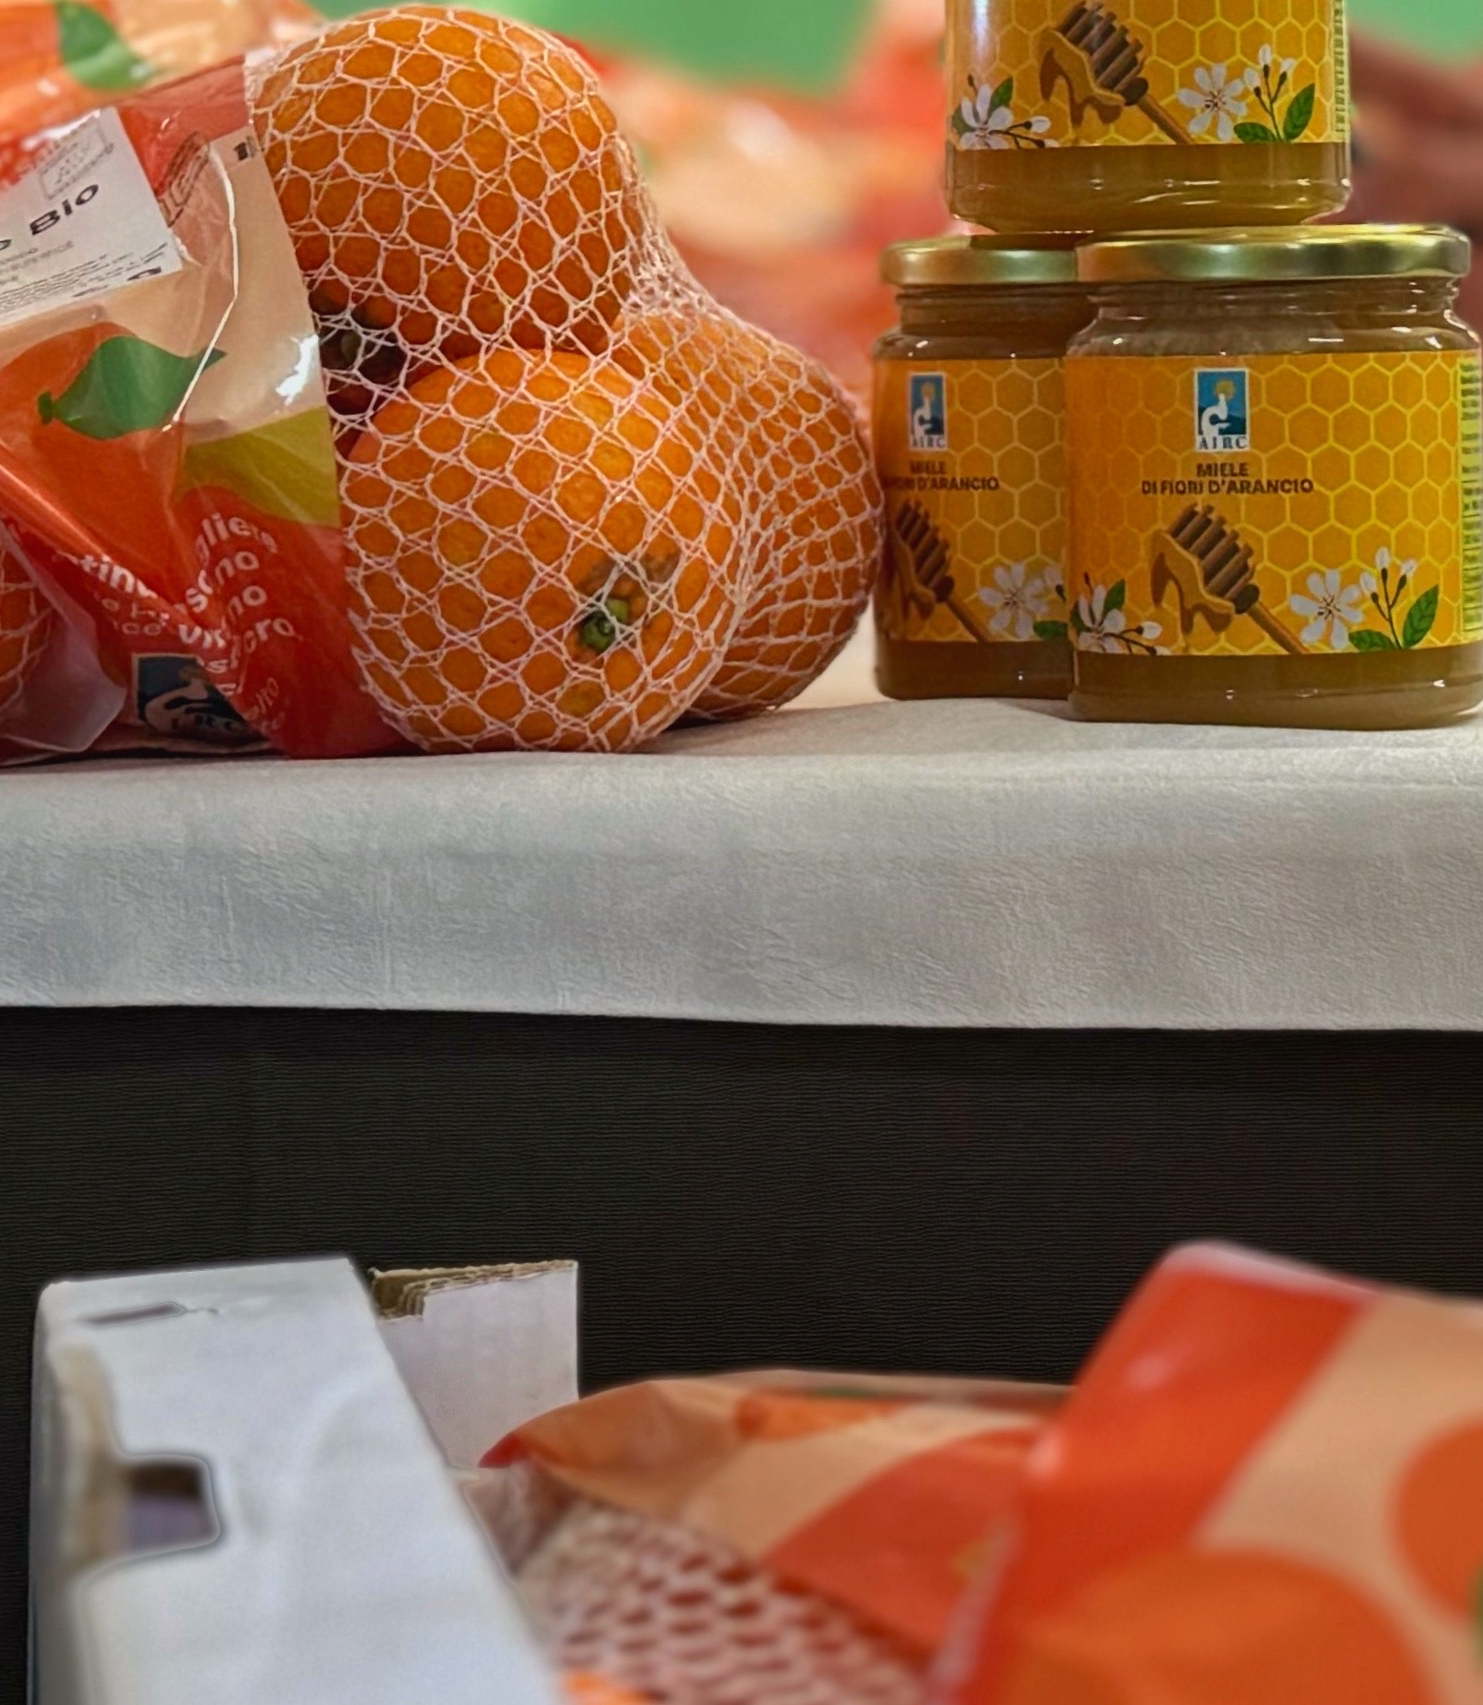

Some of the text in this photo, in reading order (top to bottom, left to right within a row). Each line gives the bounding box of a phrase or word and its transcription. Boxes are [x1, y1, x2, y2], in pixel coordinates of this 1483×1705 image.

[1198, 436, 1248, 450] AIRC
[1196, 462, 1249, 478] MIELE
[918, 475, 1000, 492] D'ARANCIO
[1140, 478, 1315, 496] DI FIORI D'ARANCIO
